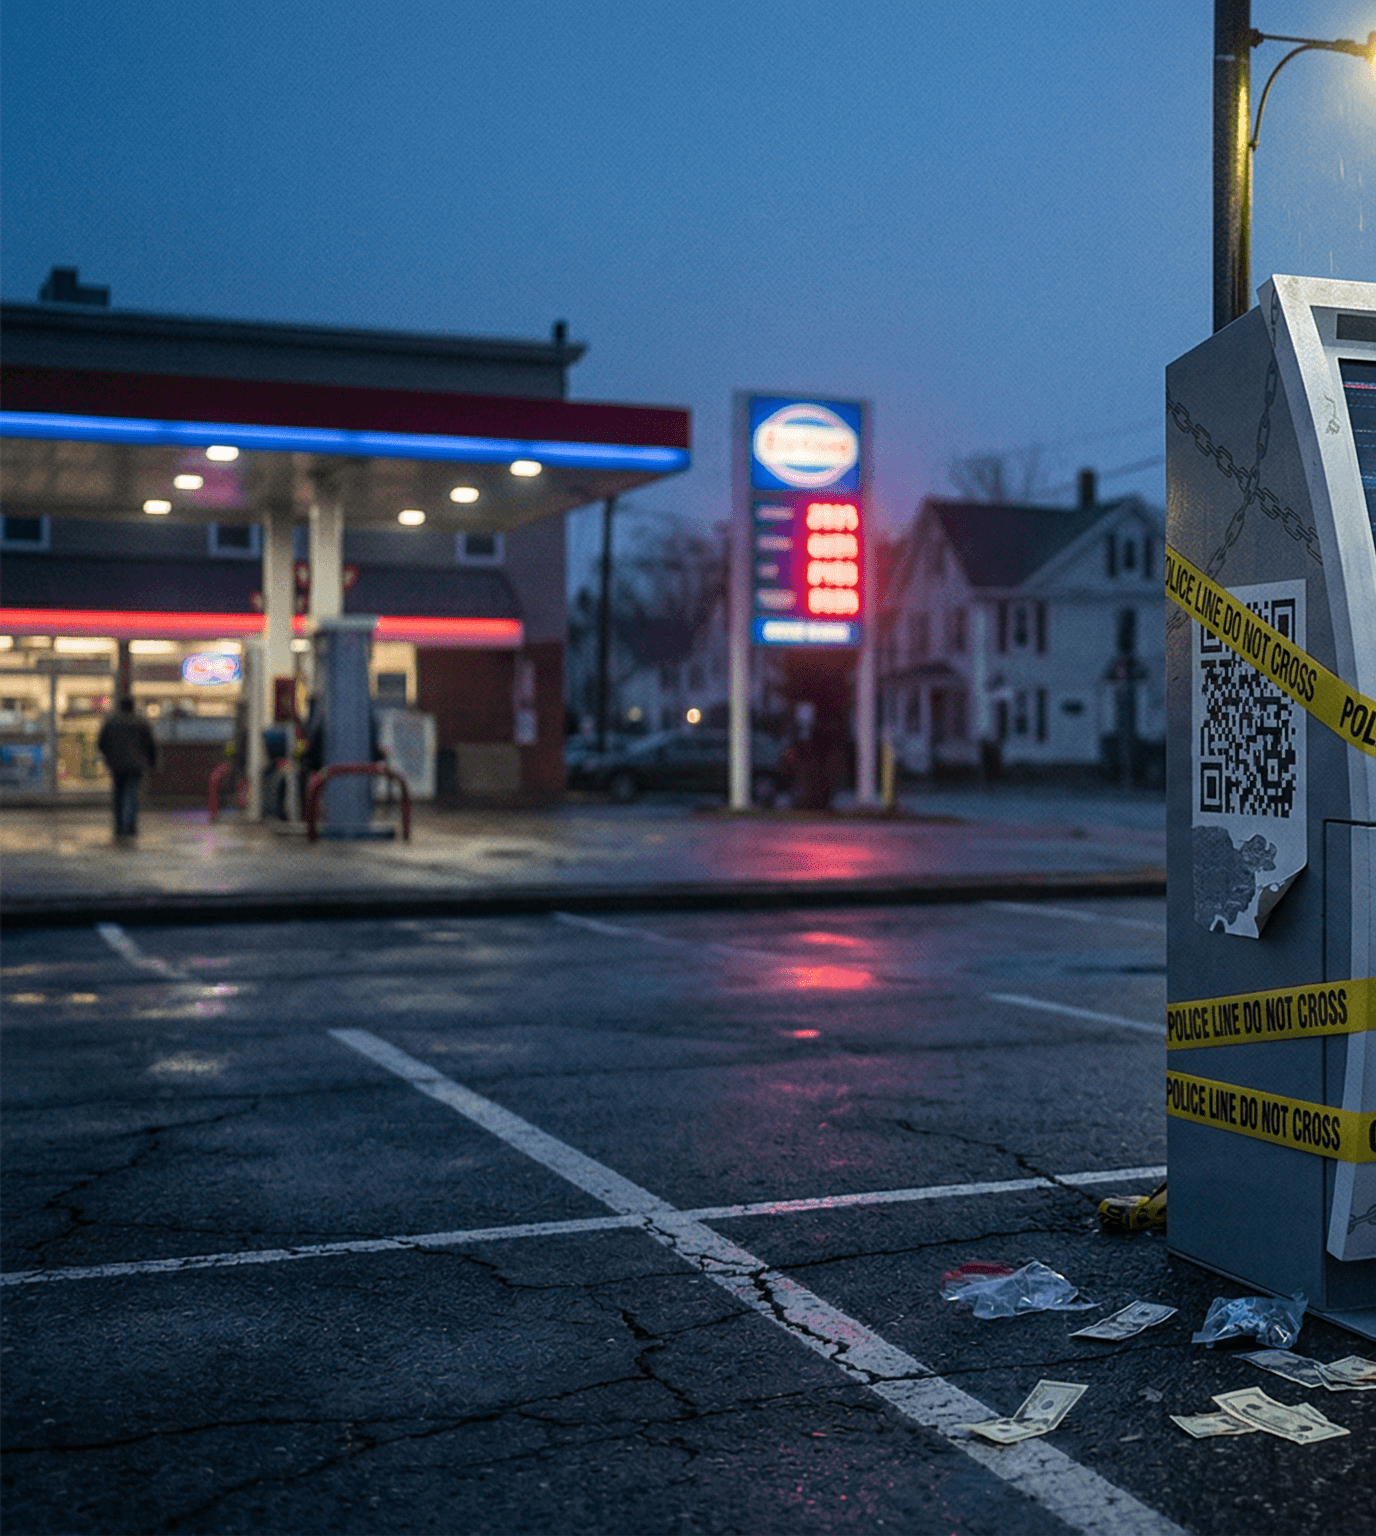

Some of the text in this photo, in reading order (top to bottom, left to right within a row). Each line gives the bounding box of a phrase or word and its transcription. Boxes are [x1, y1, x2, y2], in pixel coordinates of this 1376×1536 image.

[1194, 581, 1224, 628] LINE
[1222, 603, 1242, 643] DO
[1242, 618, 1272, 665] NOT
[1271, 642, 1318, 702] CROSS
[1167, 1006, 1210, 1042] POLICE
[1211, 1002, 1241, 1037] LINE
[1243, 999, 1262, 1034] DO
[1265, 996, 1293, 1032] NOT
[1297, 988, 1348, 1029] CROSS
[1166, 1077, 1206, 1117] POLICE
[1209, 1087, 1237, 1125] LINE
[1240, 1094, 1258, 1130] DO
[1261, 1100, 1289, 1138] NOT
[1292, 1107, 1341, 1151] CROSS
